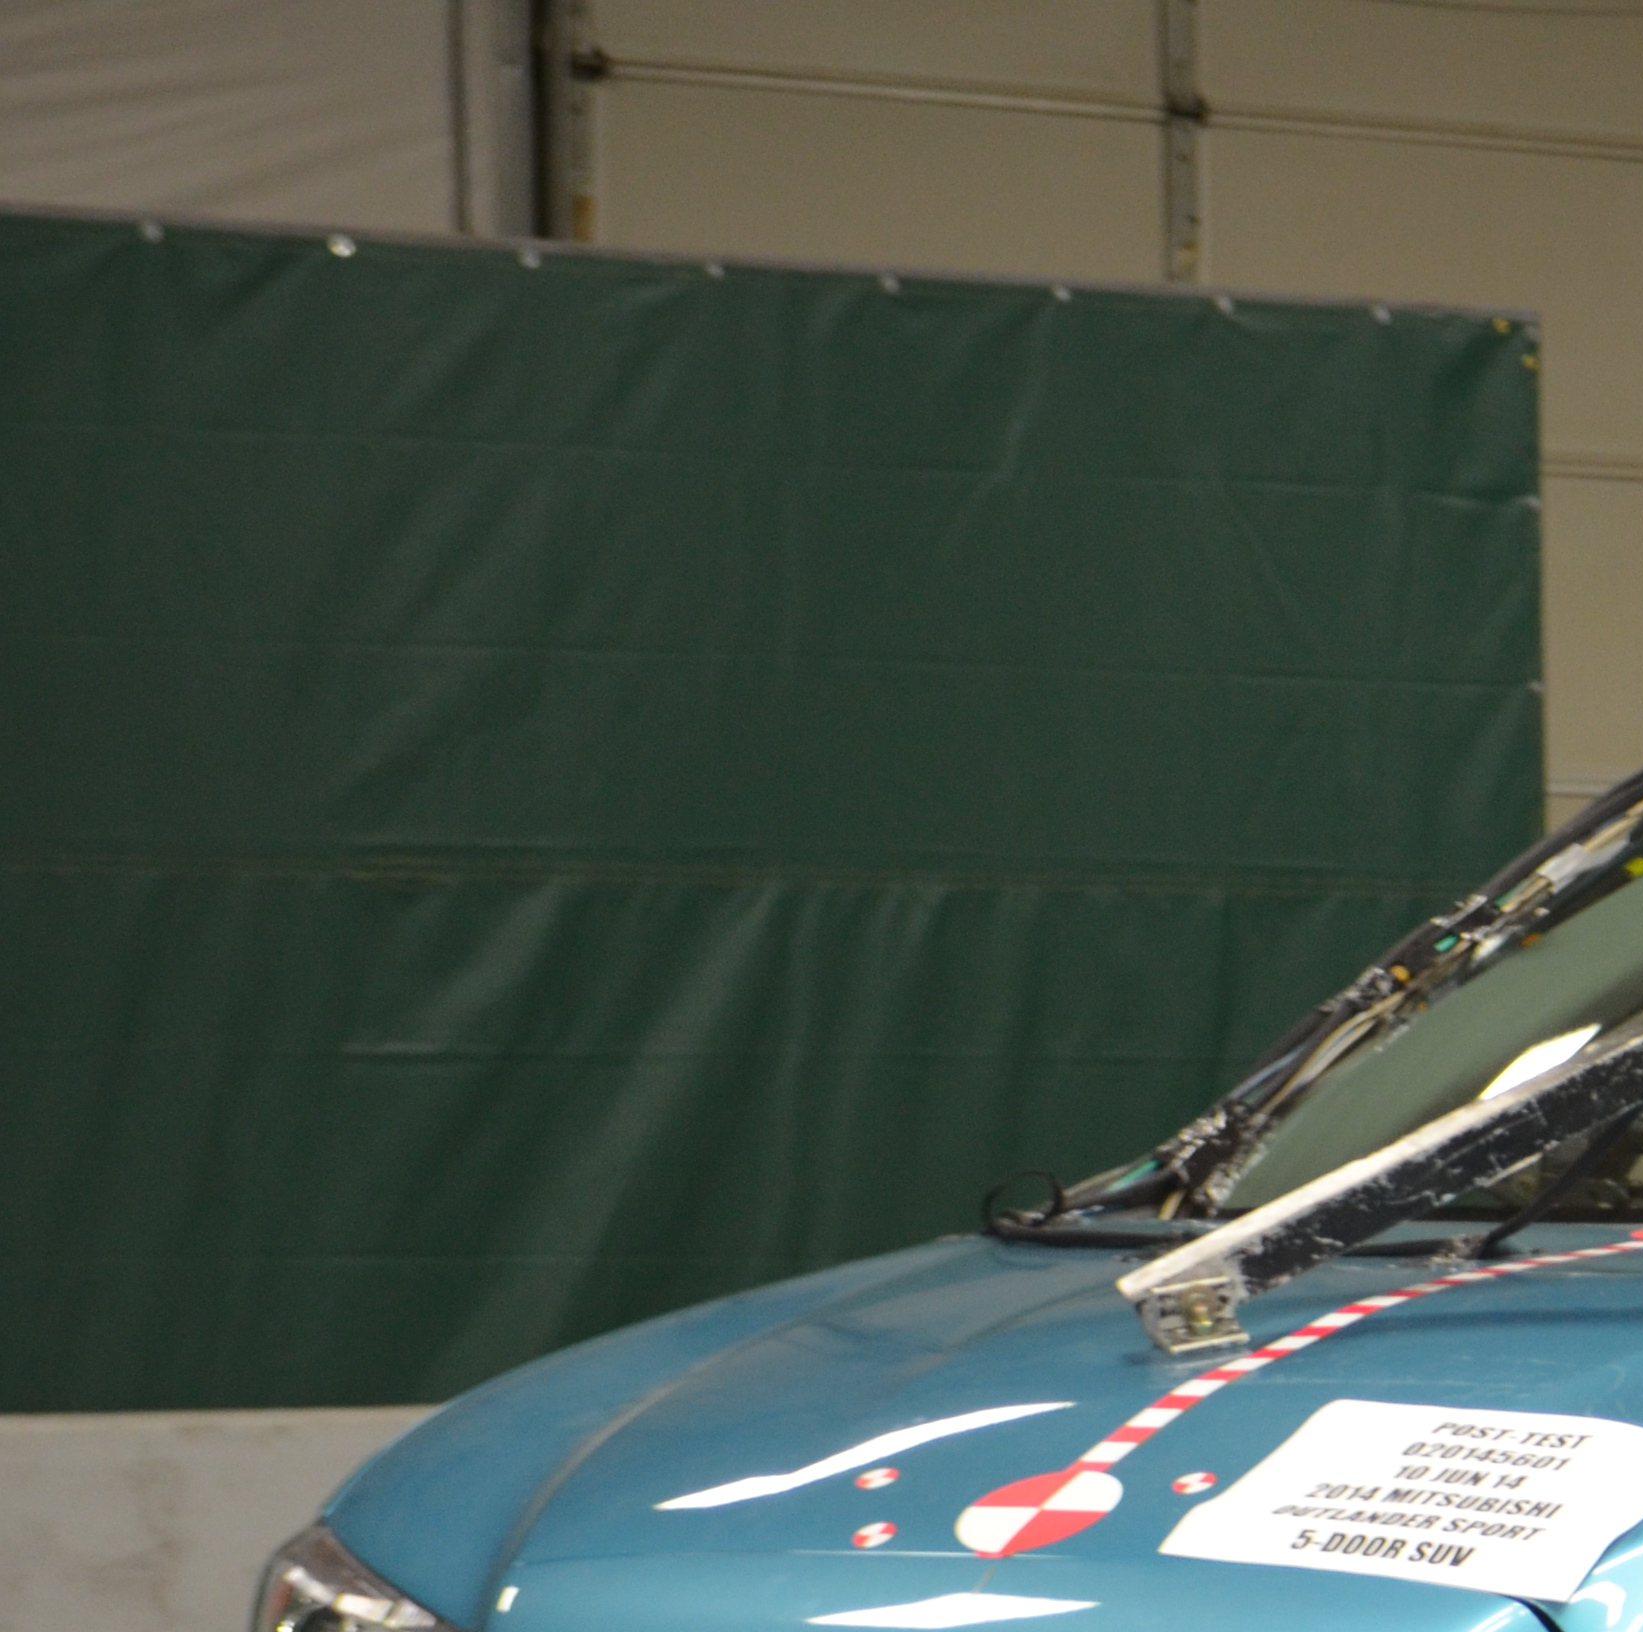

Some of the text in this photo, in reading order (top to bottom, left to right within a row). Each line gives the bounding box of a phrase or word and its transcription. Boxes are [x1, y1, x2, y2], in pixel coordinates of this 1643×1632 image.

[1431, 1422, 1592, 1450] POST-TEST
[1402, 1442, 1571, 1472] 020145601
[1393, 1465, 1528, 1490] 10 JUN 14
[1305, 1483, 1564, 1520] 2014 MITSUBISHI
[1272, 1504, 1546, 1542] OUTLANDER SPORT
[1291, 1530, 1474, 1568] 5-DOOR SUV
